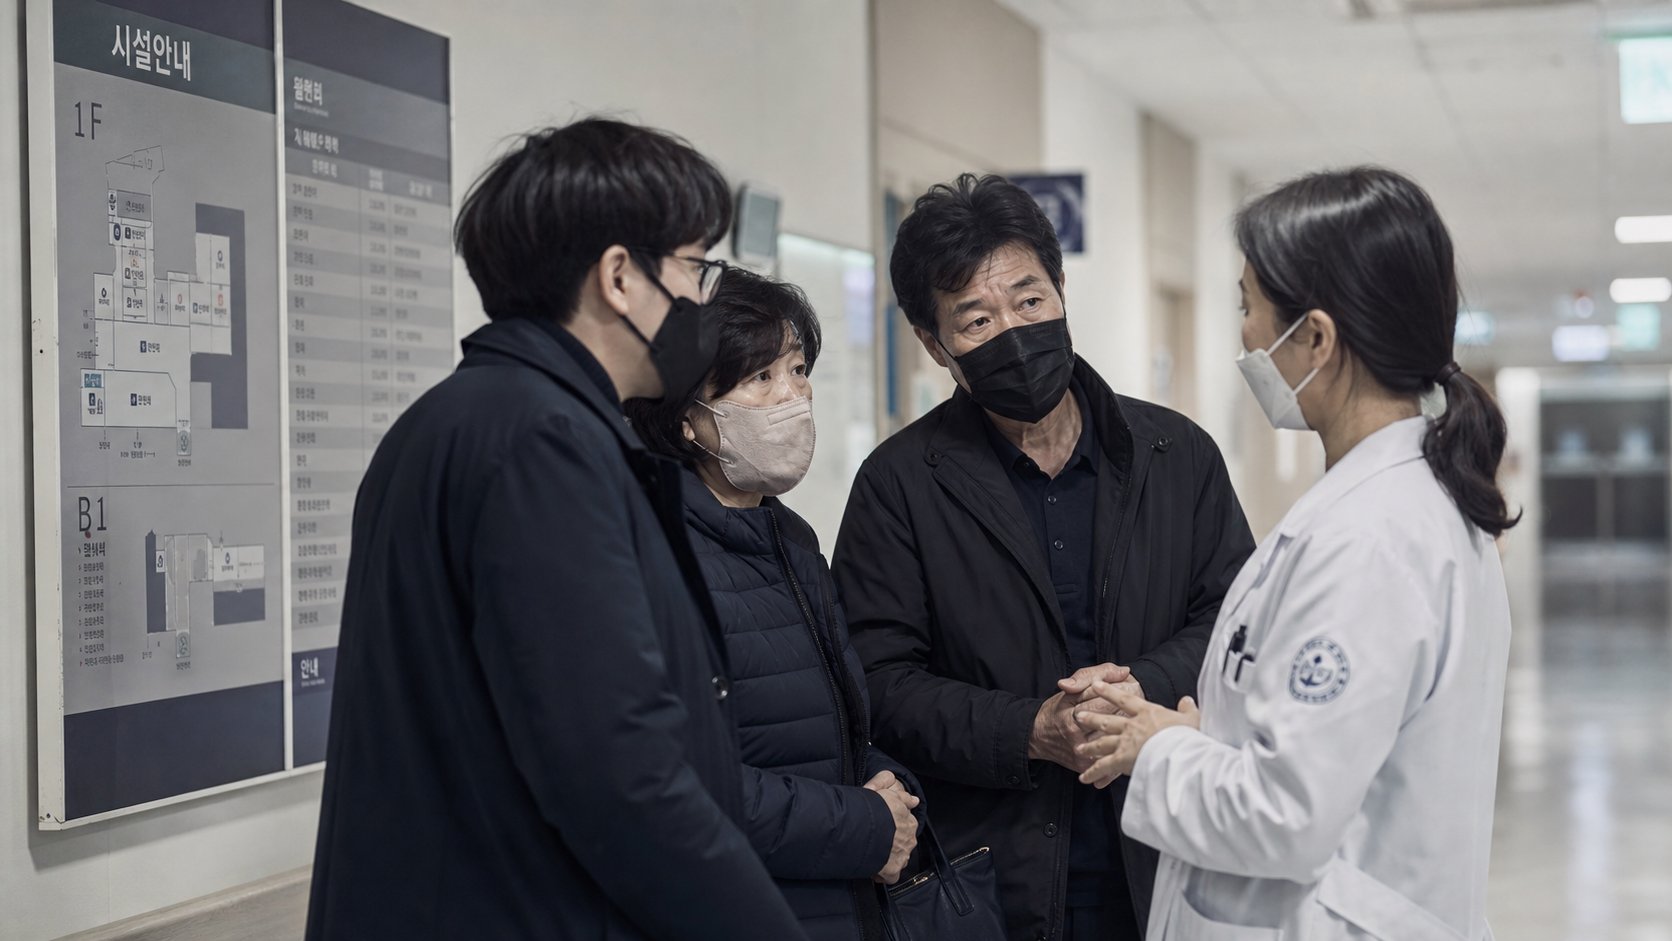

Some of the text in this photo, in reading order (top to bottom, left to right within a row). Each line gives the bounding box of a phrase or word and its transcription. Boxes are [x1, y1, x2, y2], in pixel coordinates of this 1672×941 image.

[111, 24, 191, 82] 시설안내
[74, 101, 102, 140] 1F
[78, 496, 107, 532] B1
[300, 657, 319, 679] 안내
